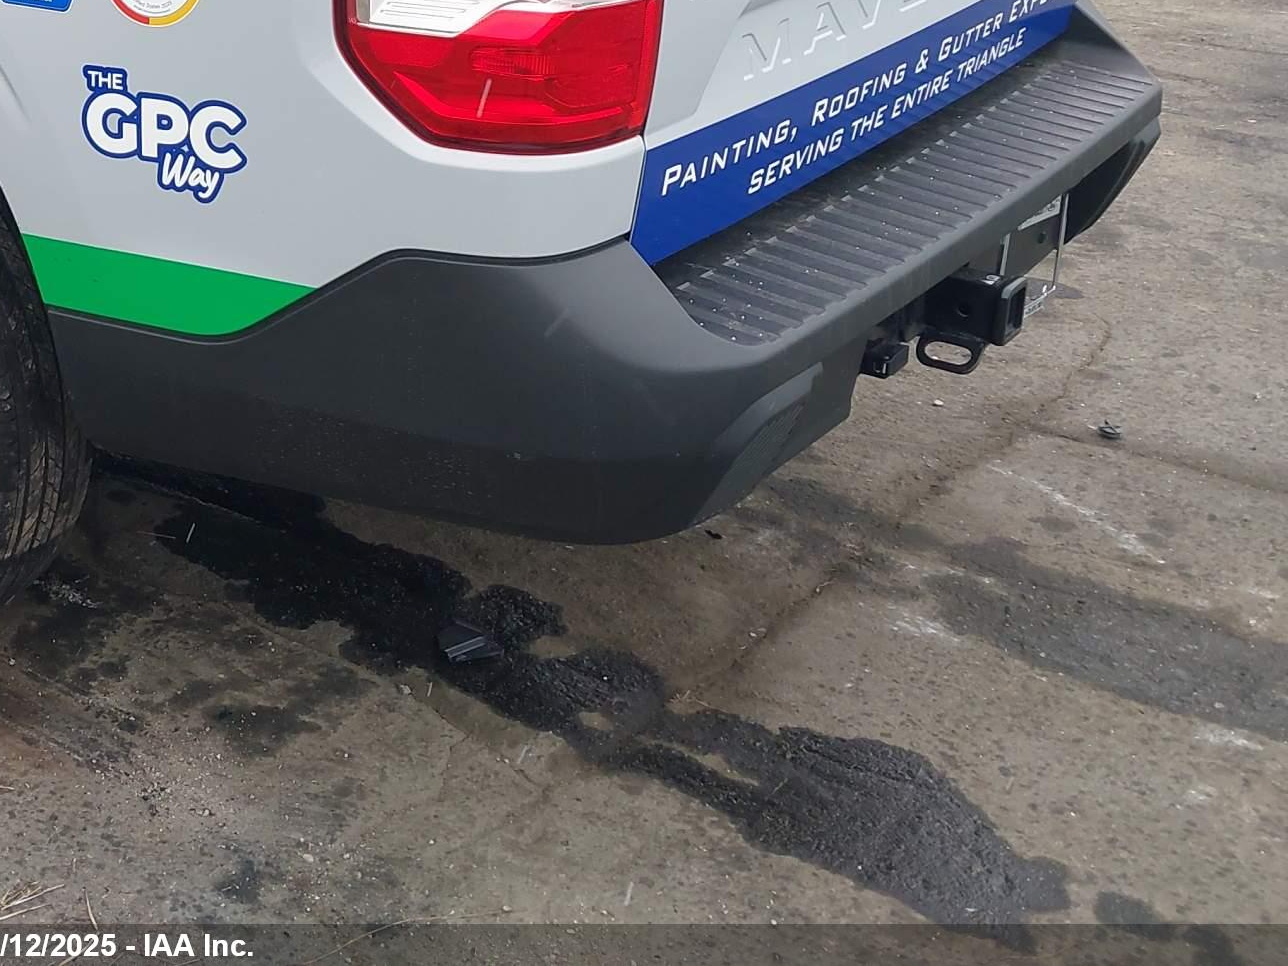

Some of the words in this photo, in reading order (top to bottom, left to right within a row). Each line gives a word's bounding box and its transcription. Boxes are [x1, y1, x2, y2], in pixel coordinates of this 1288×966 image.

[88, 70, 123, 90] THE
[660, 117, 798, 196] PAINTING,
[811, 62, 908, 127] ROOFING
[914, 48, 931, 75] &
[938, 12, 1004, 62] GUTTER
[747, 128, 844, 194] SERVING
[850, 103, 889, 140] THE
[891, 69, 954, 119] ENTIRE
[955, 27, 1027, 83] TRIANGLE
[85, 92, 243, 169] GPC
[161, 151, 219, 198] Way
